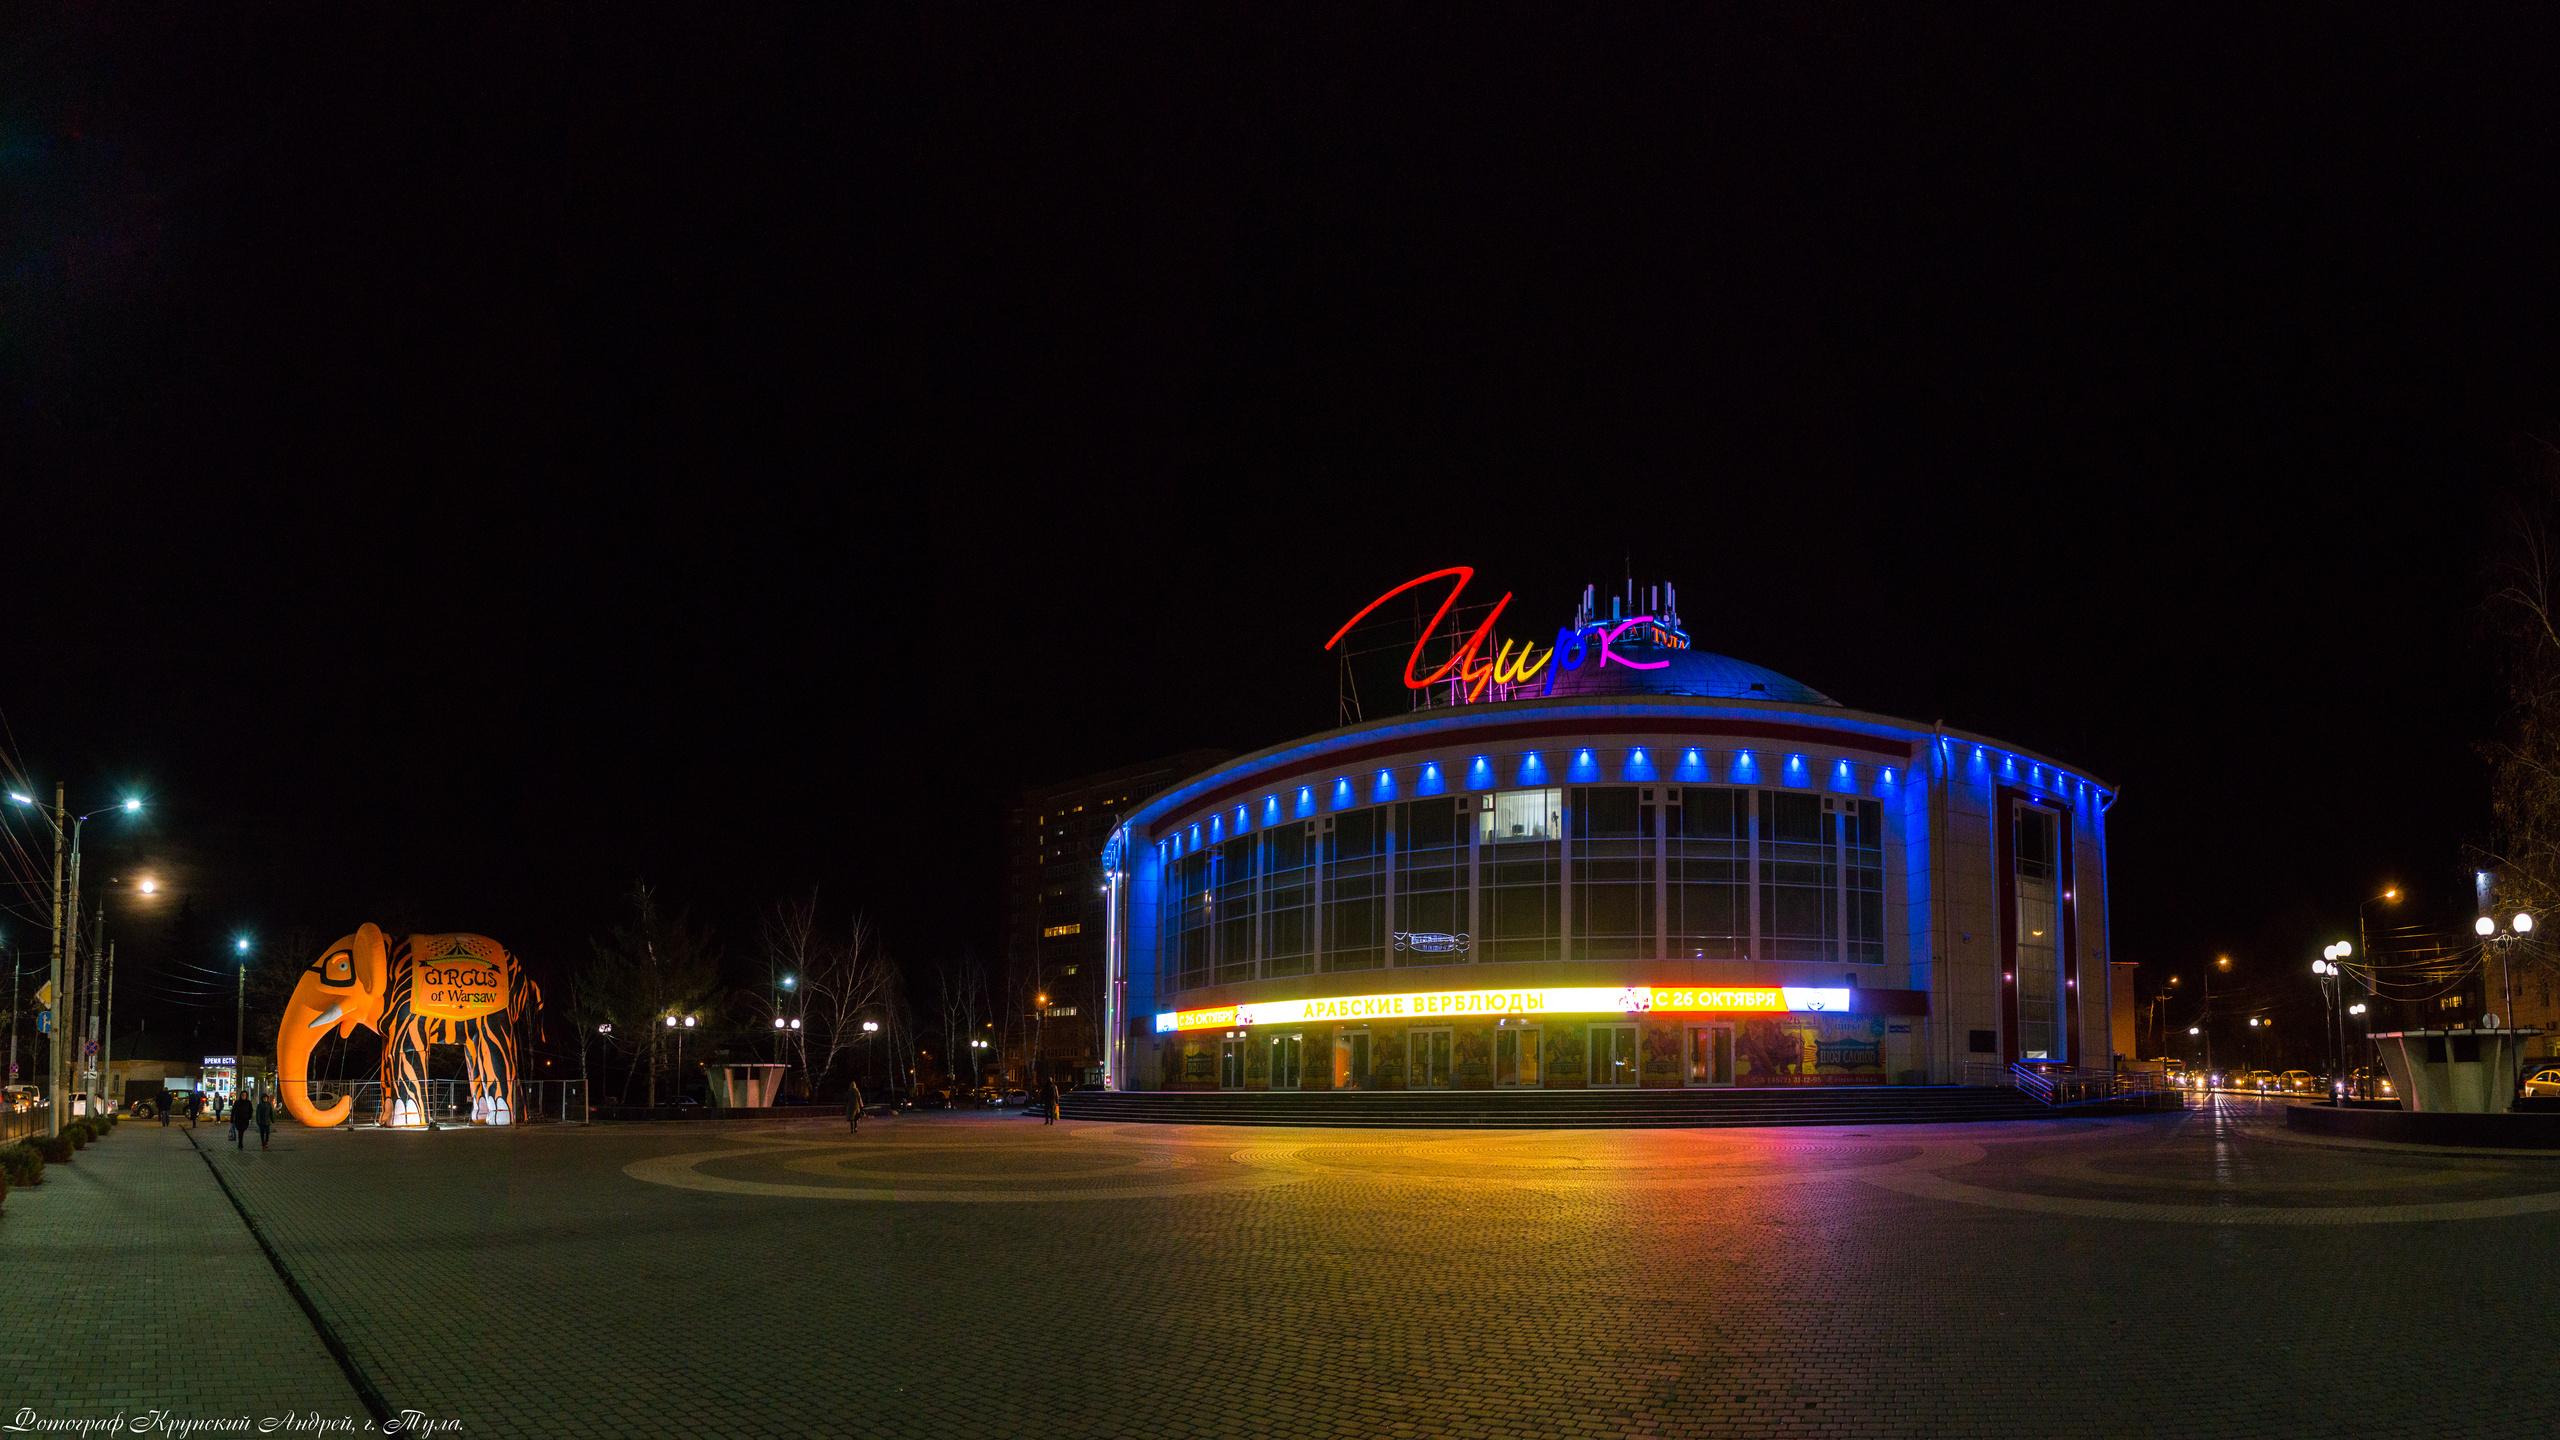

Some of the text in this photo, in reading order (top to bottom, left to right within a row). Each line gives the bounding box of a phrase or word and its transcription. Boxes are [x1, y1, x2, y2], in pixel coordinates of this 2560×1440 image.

[1324, 566, 1670, 703] Цирк
[1651, 627, 1688, 650] ТУЛА
[425, 969, 497, 989] CIRCUS
[431, 990, 497, 1004] of Warsaw
[1655, 992, 1777, 1007] С 26 ОКТЯБРЯ
[1303, 993, 1545, 1019] АРАБСКИЕ ВЕРБЛЮДЫ
[1179, 1010, 1234, 1027] С 26 ОКТЯБРЯ
[1786, 1016, 1801, 1025] 26
[1820, 1050, 1841, 1063] ШОУ
